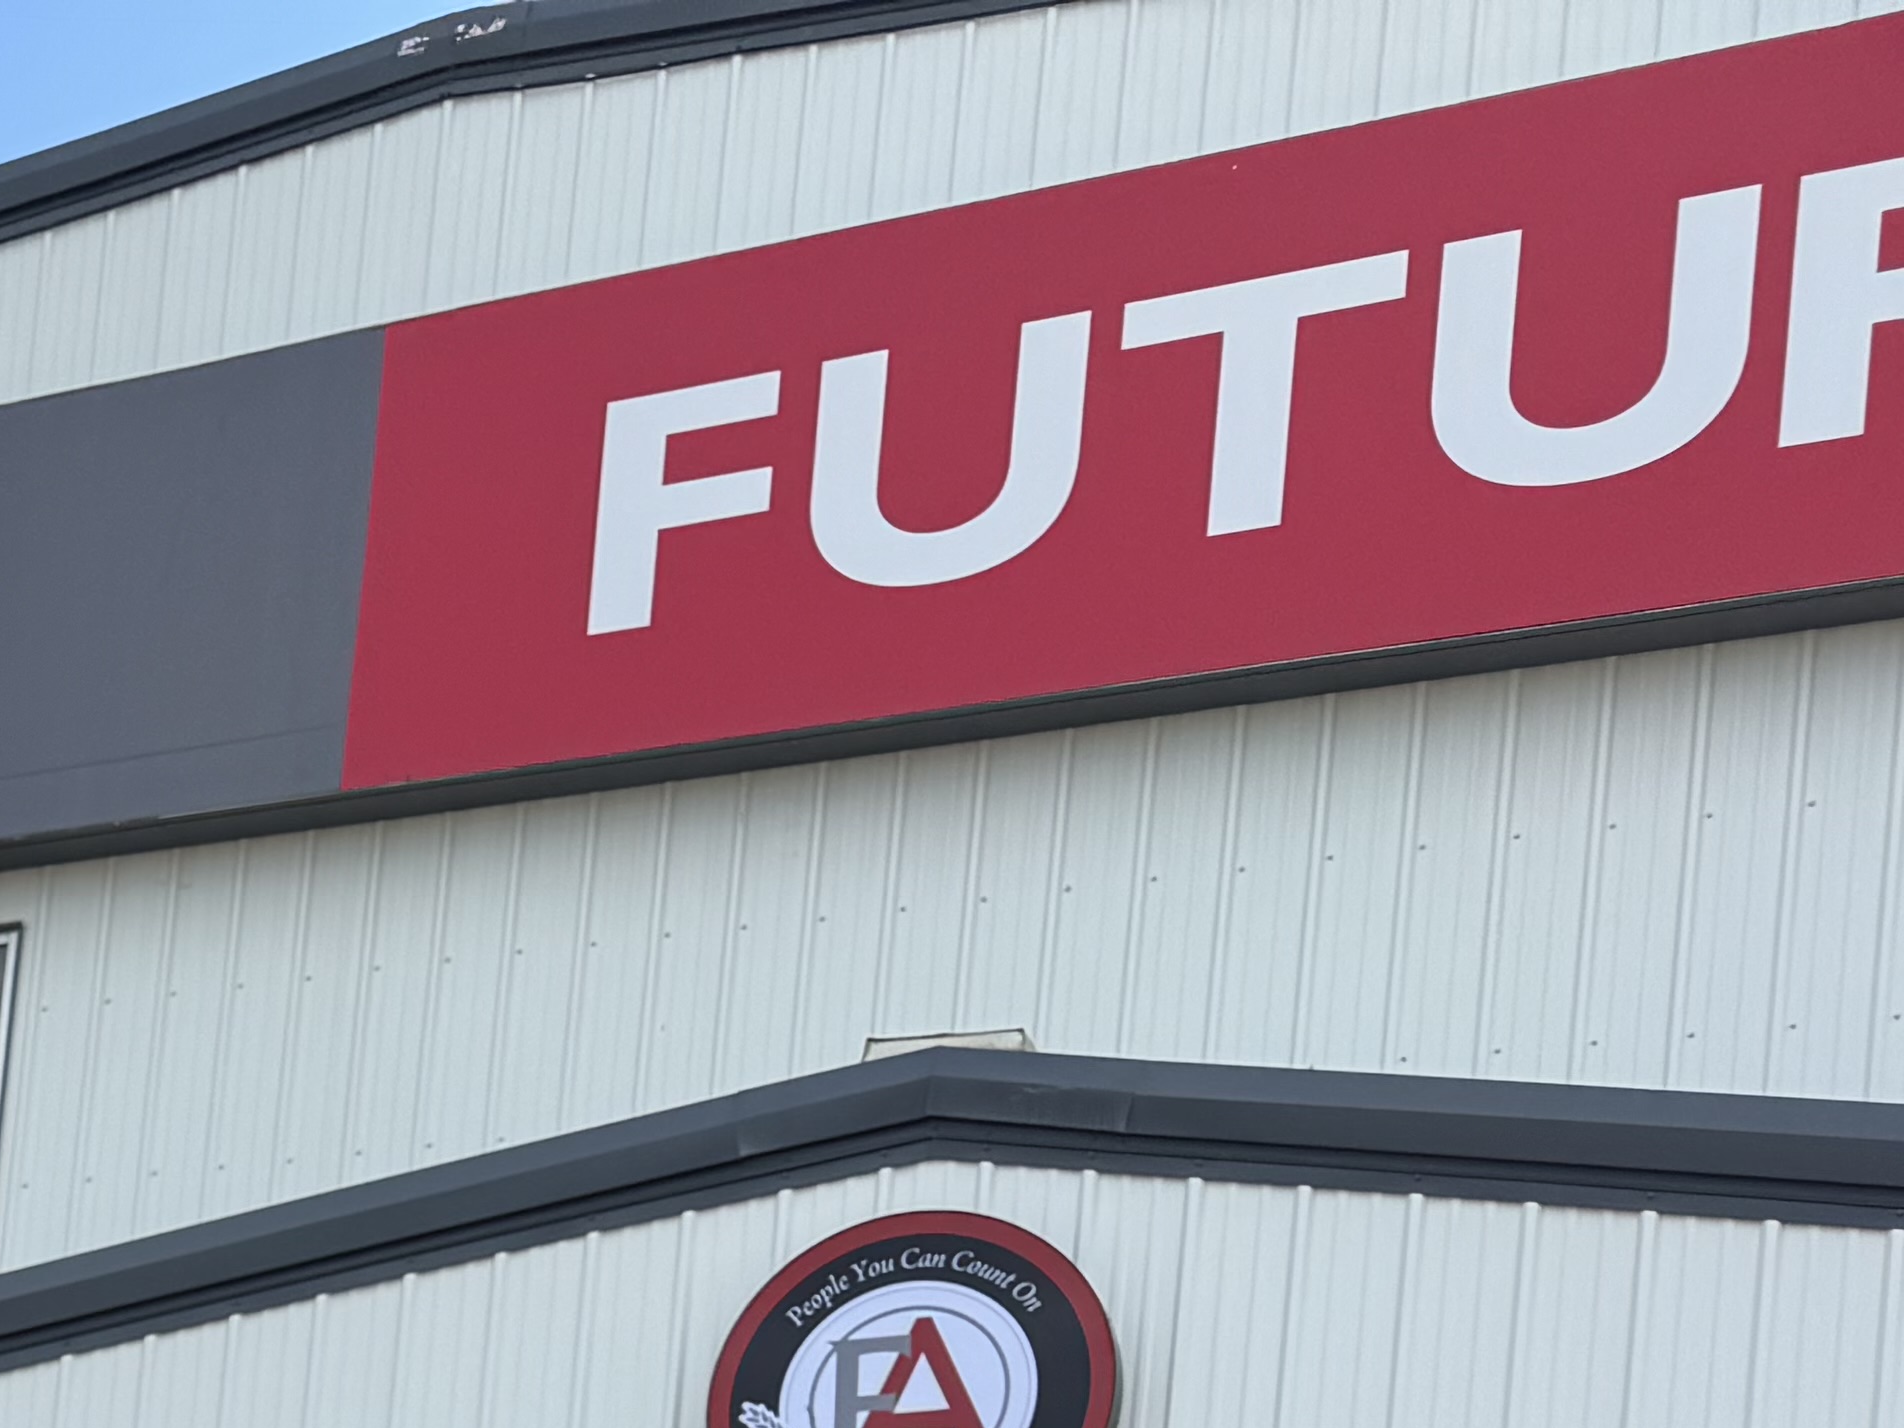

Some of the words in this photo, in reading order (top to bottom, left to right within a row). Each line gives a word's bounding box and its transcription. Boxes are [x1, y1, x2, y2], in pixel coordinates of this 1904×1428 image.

[785, 1272, 851, 1328] People
[850, 1257, 896, 1284] You
[900, 1246, 946, 1271] Can
[951, 1249, 1018, 1291] Count
[1011, 1280, 1043, 1314] On
